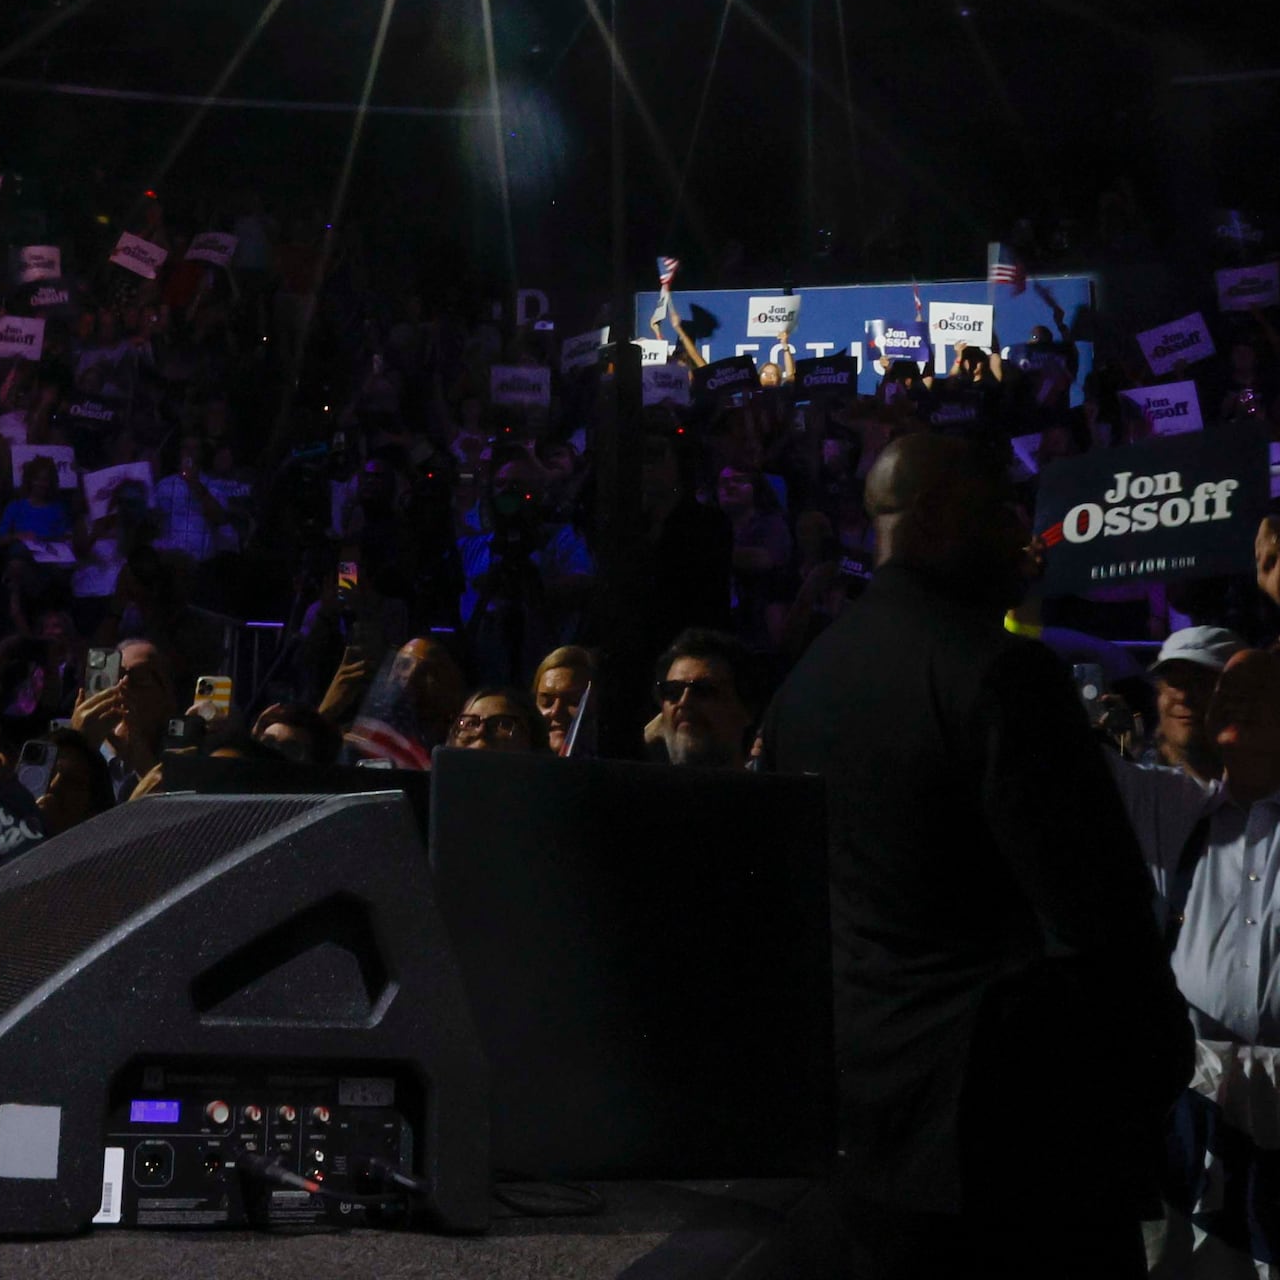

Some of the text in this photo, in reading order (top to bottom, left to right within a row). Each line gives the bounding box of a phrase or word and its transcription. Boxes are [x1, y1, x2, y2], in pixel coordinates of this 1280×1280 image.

[768, 305, 786, 315] Jon
[949, 312, 969, 322] Jon
[758, 311, 796, 324] Ossoff
[938, 318, 984, 332] Ossoff
[885, 327, 907, 338] Jon
[1153, 331, 1202, 359] Ossoff
[1145, 397, 1170, 411] Jon
[1148, 401, 1189, 420] ssoff
[1104, 470, 1183, 504] Jon
[1062, 478, 1240, 544] Ossoff
[1090, 555, 1197, 581] ELECTJON.COM
